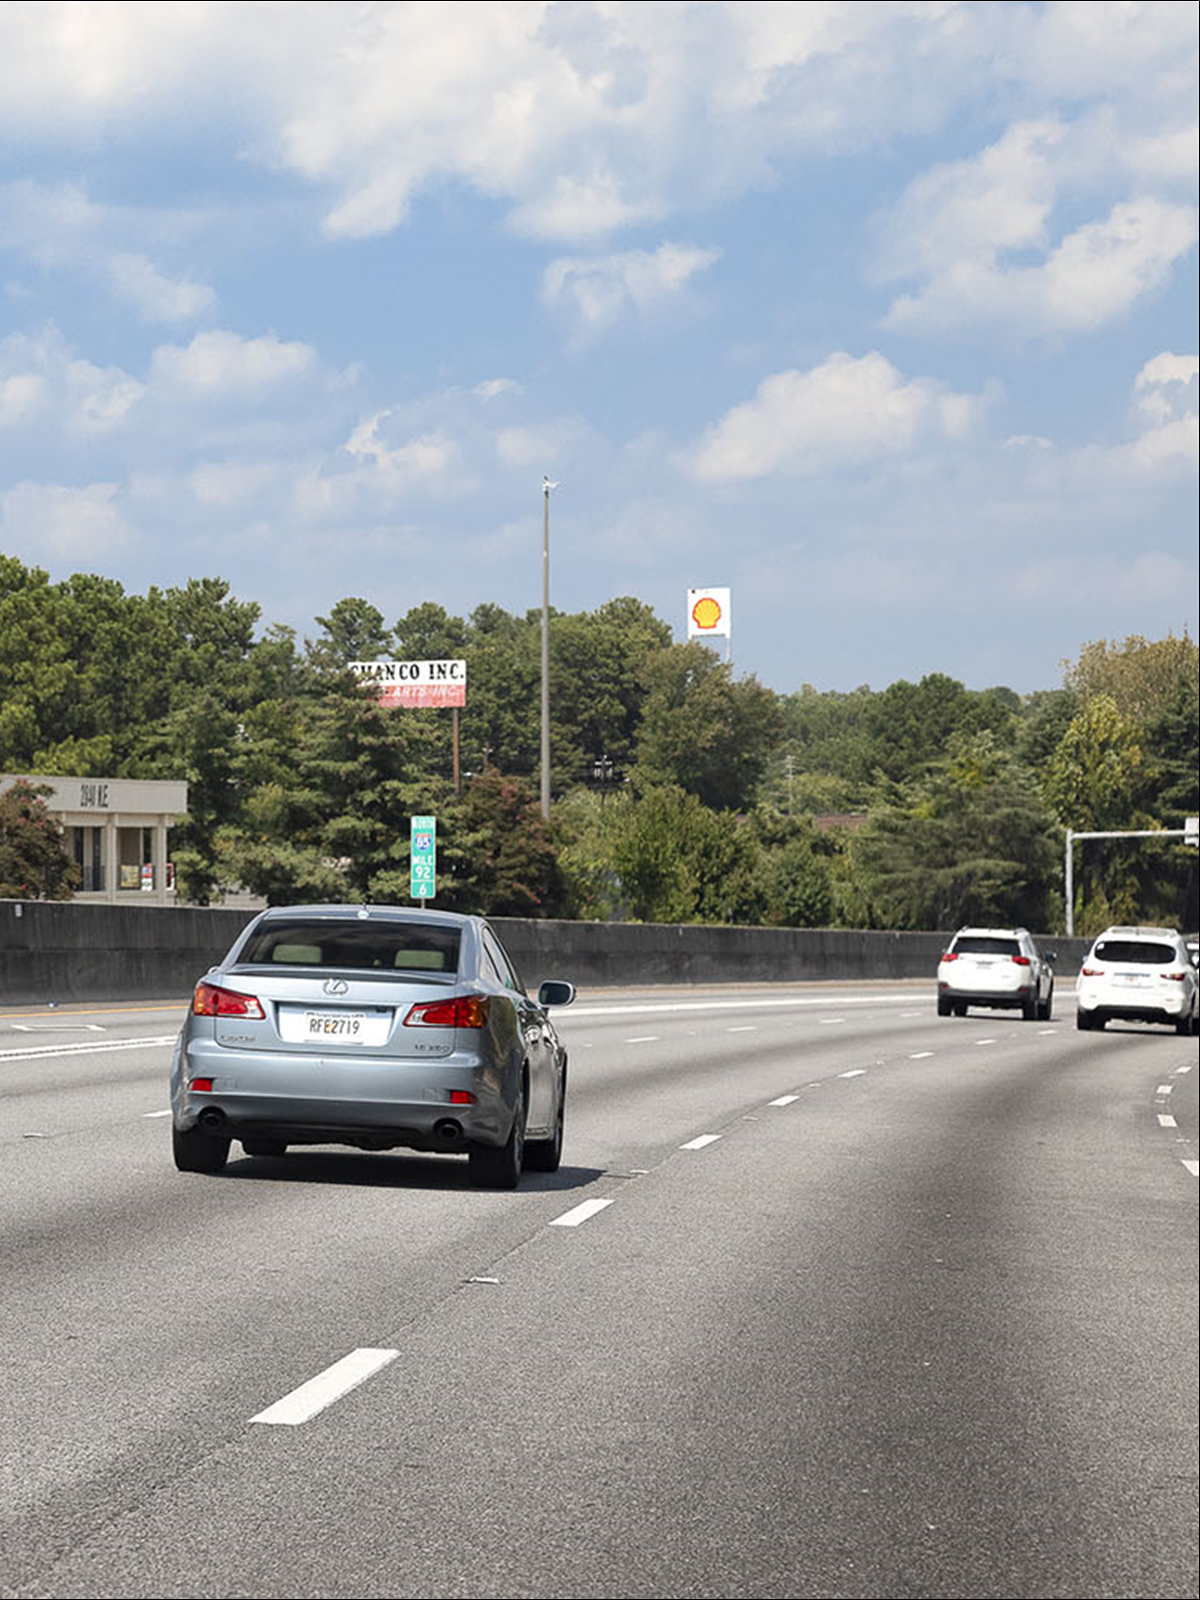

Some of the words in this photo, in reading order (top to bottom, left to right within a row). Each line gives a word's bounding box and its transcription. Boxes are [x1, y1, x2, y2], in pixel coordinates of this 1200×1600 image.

[429, 663, 464, 679] INC.
[415, 866, 431, 879] 92
[310, 1018, 361, 1035] RFE2719
